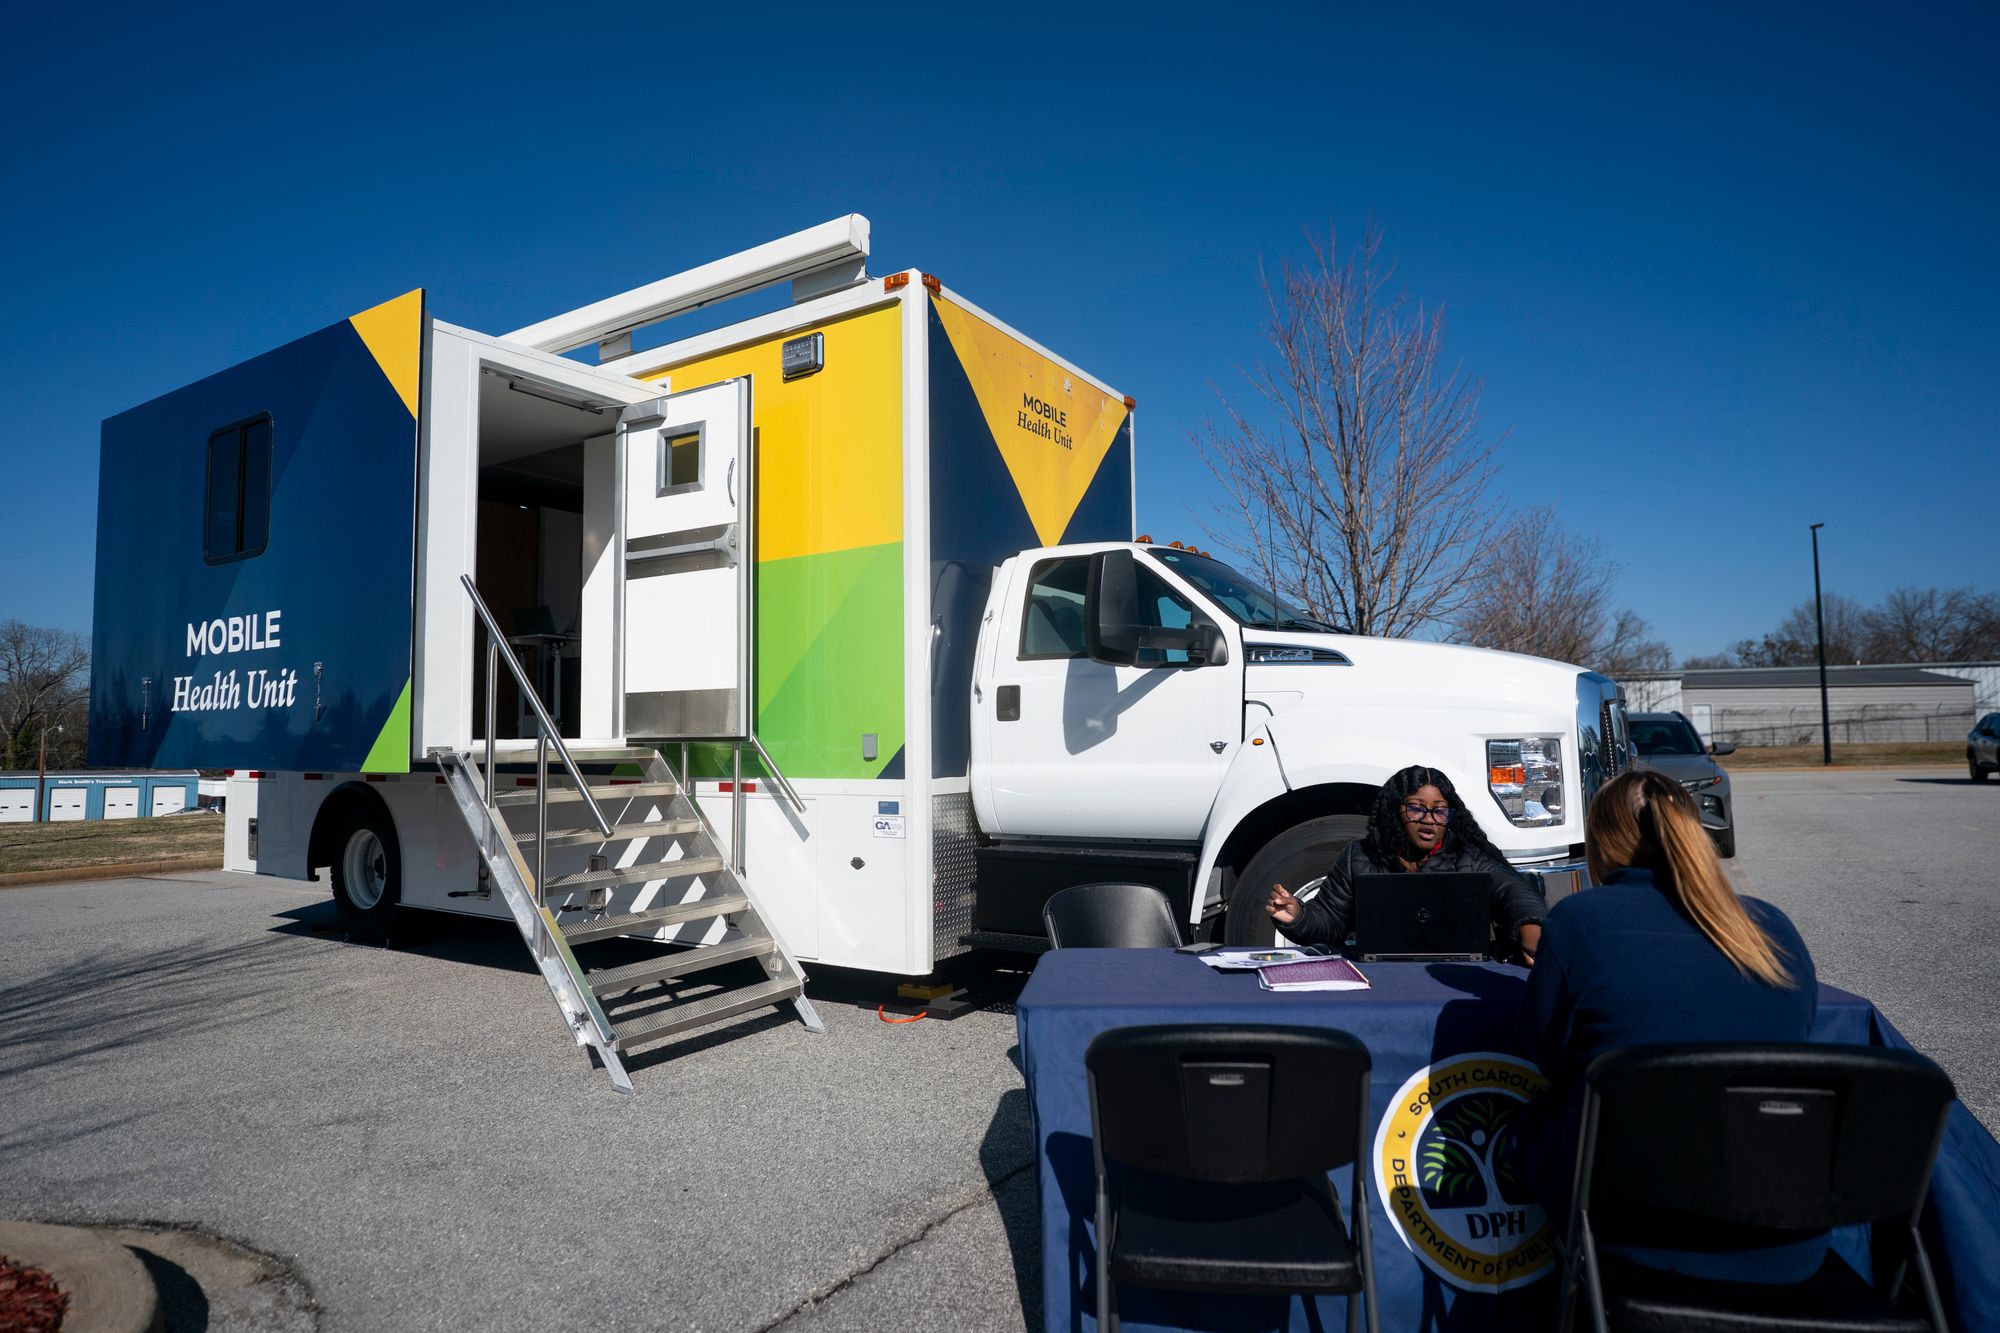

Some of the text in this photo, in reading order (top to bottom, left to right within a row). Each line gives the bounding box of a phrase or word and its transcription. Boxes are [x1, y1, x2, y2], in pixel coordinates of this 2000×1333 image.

[1017, 410, 1073, 450] Health Unit
[1023, 392, 1067, 428] MOBILE
[186, 610, 282, 657] MOBILE
[171, 667, 298, 712] Health Unit
[1409, 1071, 1468, 1116] SOUTH
[1392, 1158, 1553, 1276] DEPARTMENT OF PUBLI
[1465, 1210, 1526, 1240] DPH
